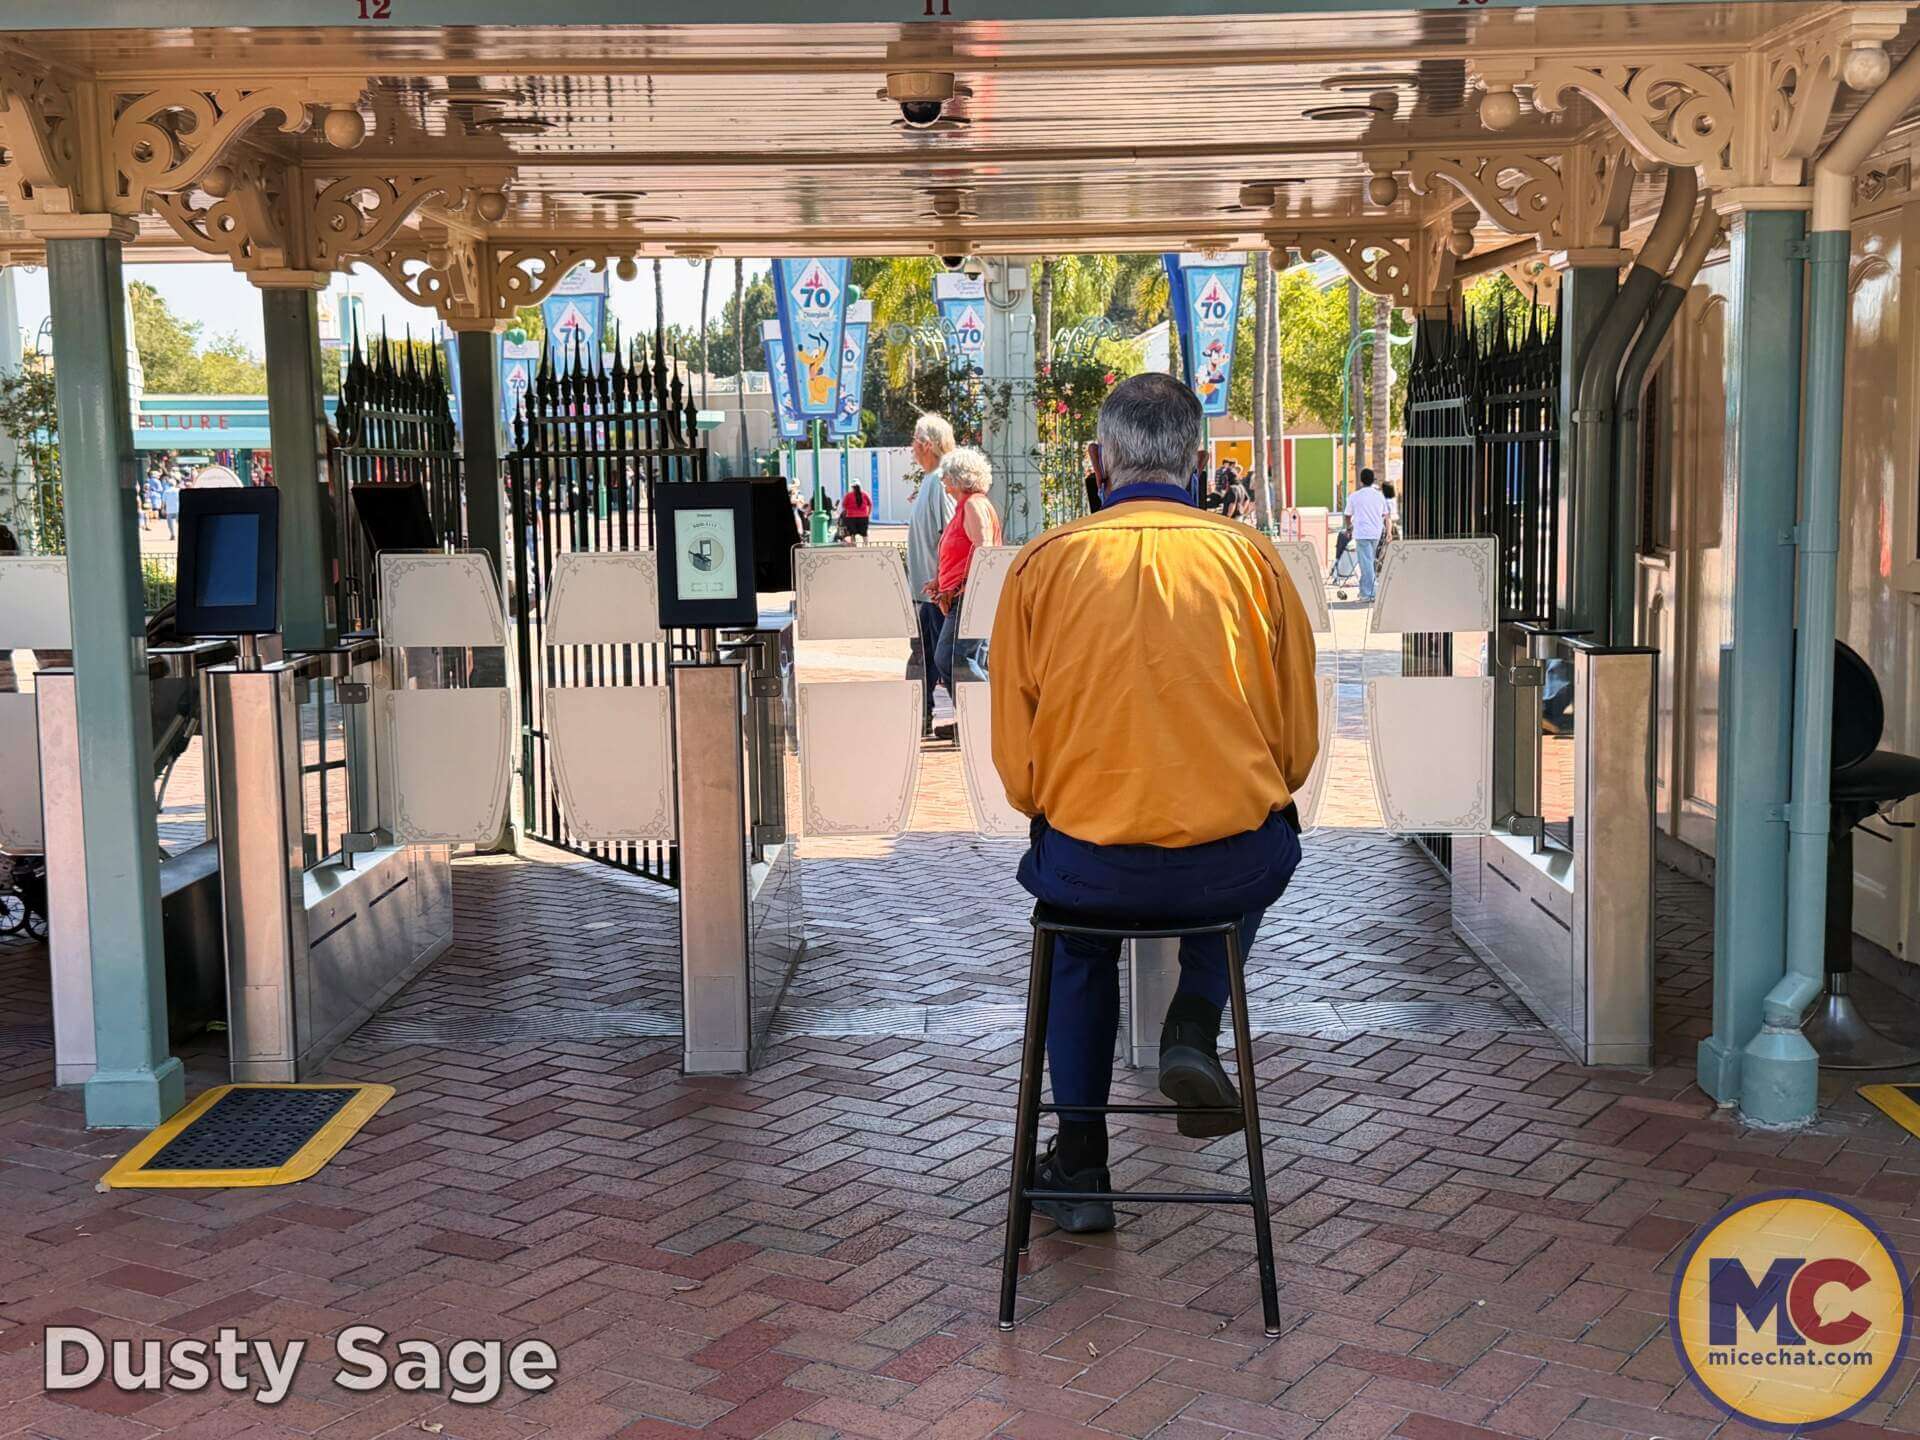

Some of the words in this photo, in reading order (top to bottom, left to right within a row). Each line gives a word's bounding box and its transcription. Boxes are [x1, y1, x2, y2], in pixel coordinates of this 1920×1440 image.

[357, 0, 392, 19] 12
[922, 0, 952, 16] 11
[800, 287, 831, 308] 70
[1201, 301, 1226, 319] 70
[560, 327, 586, 343] 70
[959, 329, 981, 343] 70
[510, 379, 526, 389] 70
